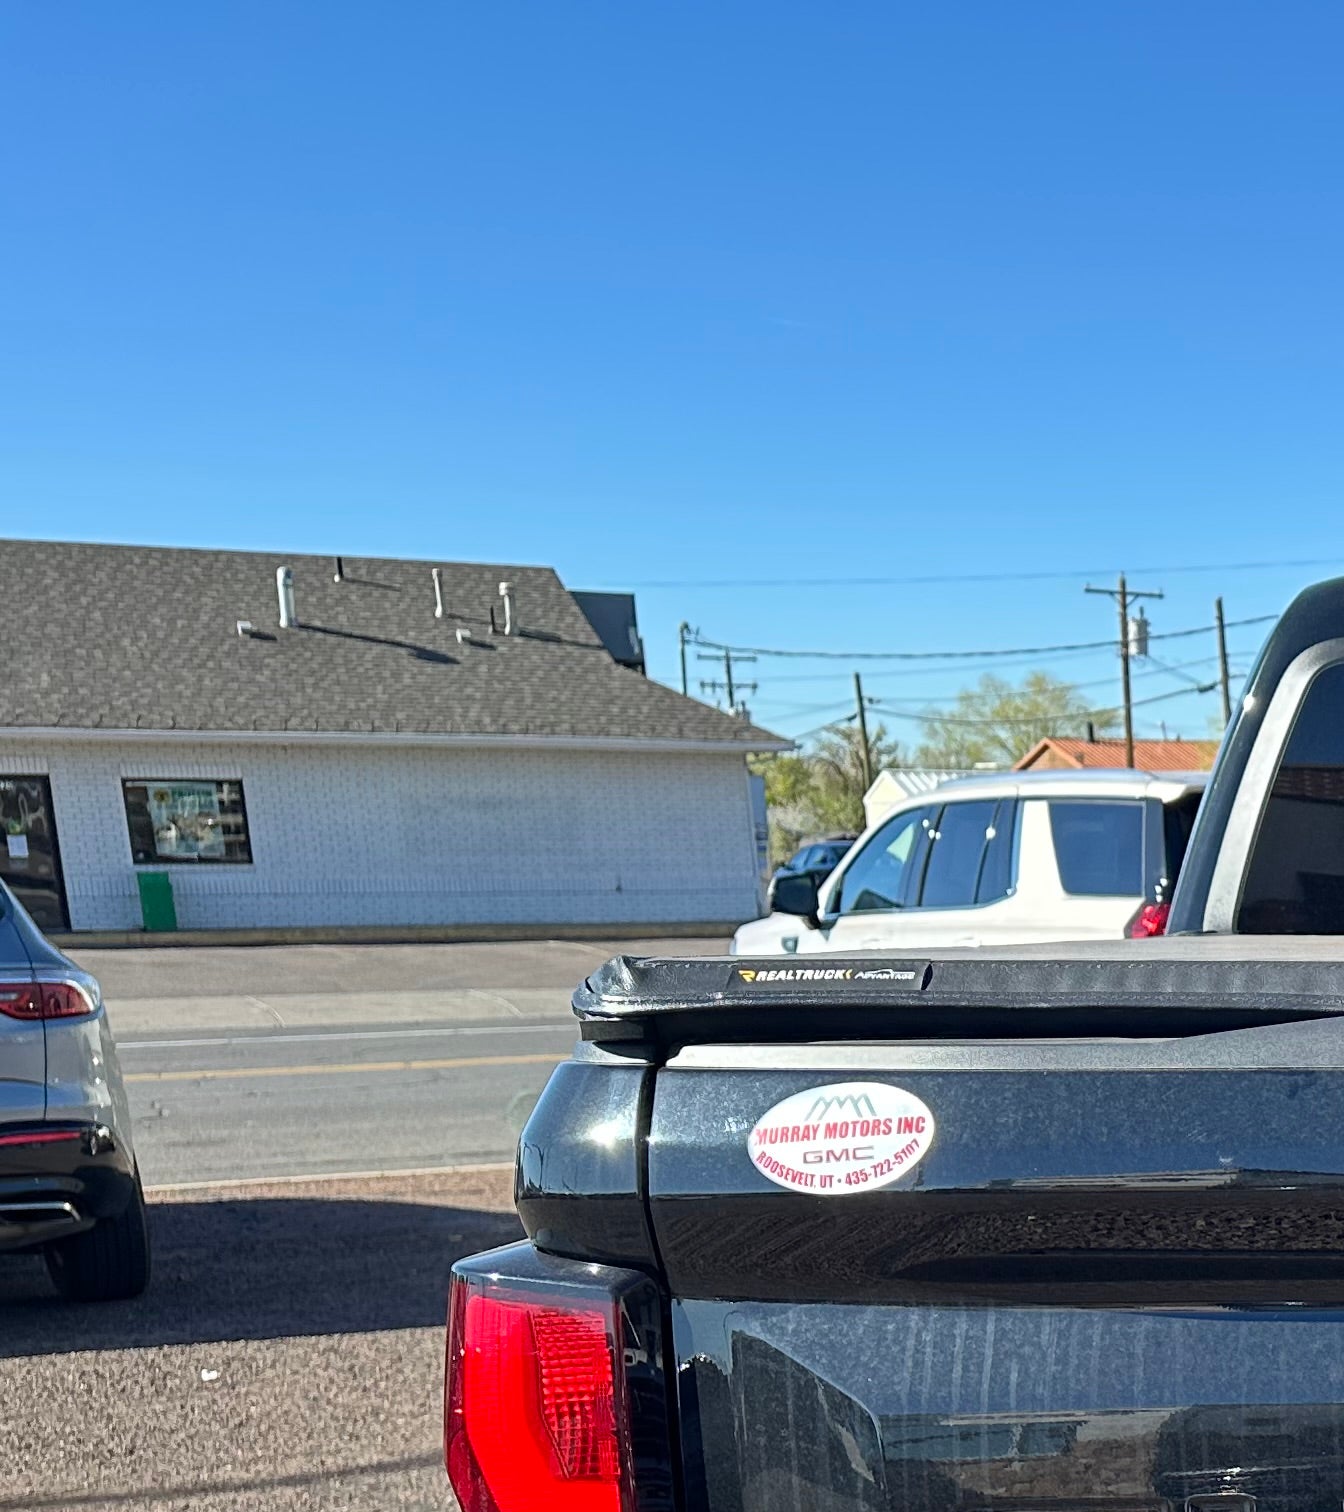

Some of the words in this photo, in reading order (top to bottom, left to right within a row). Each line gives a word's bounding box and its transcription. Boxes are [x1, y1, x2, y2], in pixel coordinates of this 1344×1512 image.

[755, 1123, 820, 1146] MURRAY
[823, 1118, 892, 1140] MOTORS
[897, 1115, 926, 1134] INC
[803, 1145, 875, 1164] GMC
[819, 1174, 835, 1188] UT
